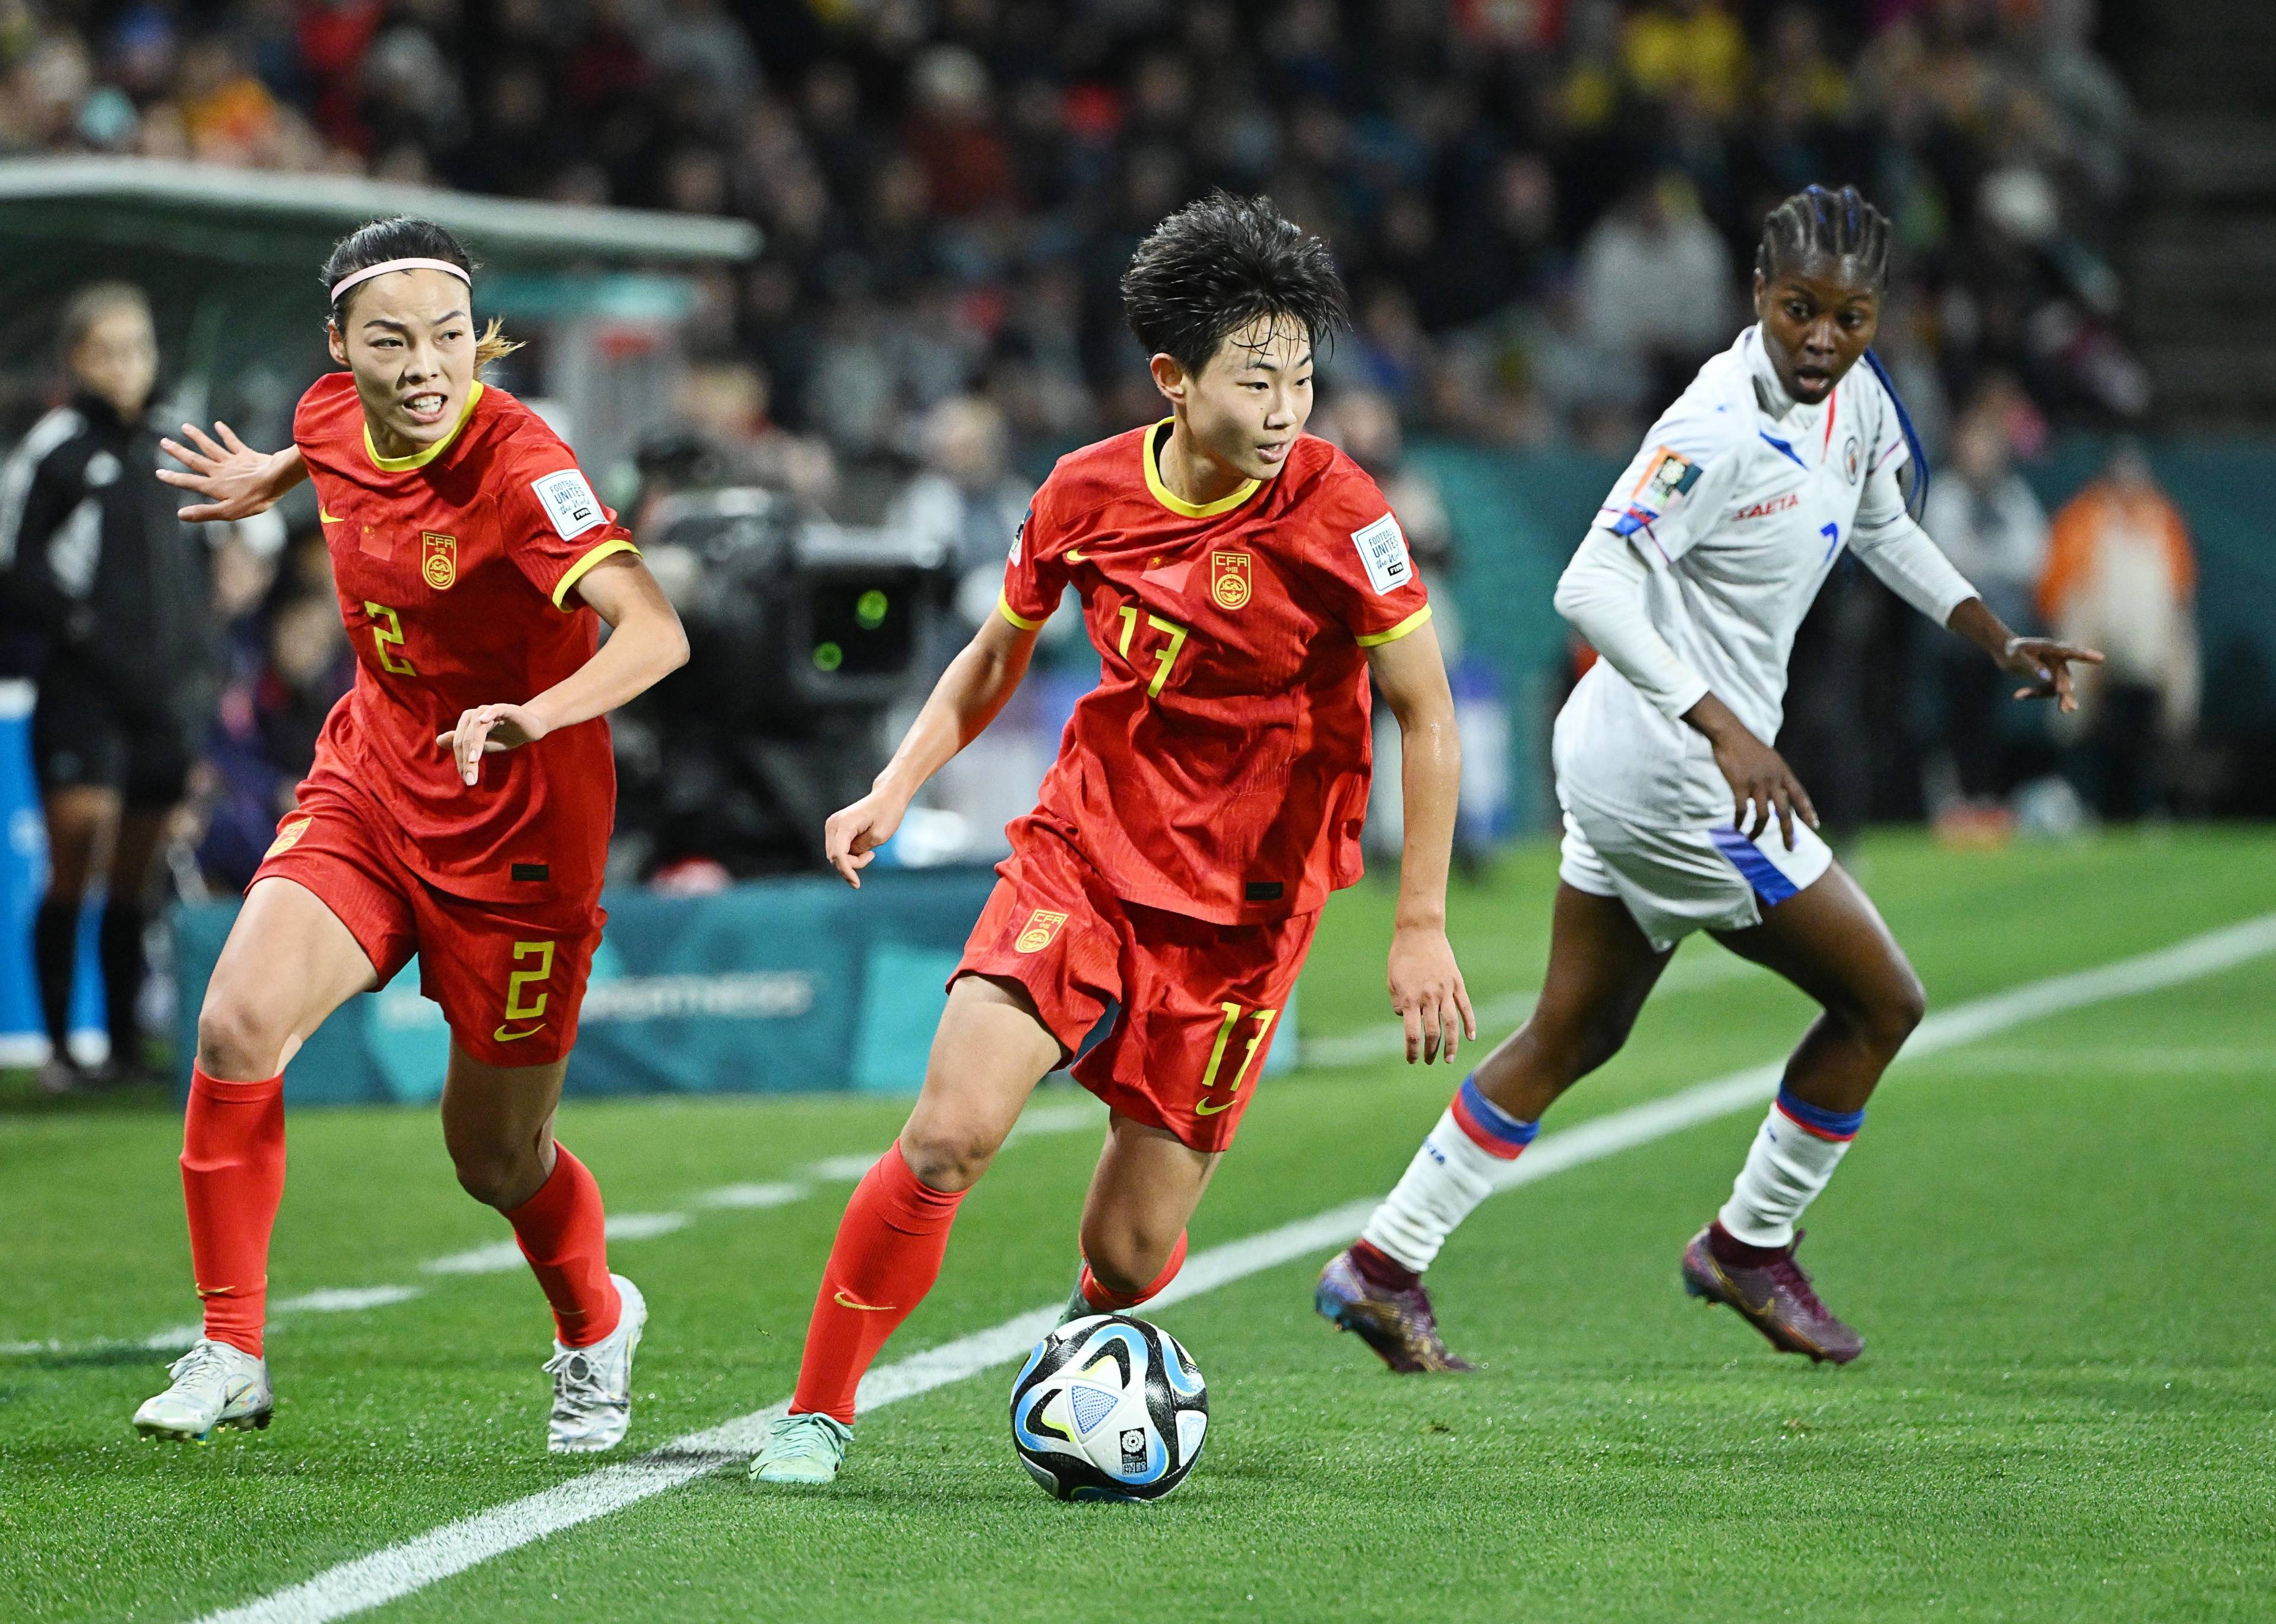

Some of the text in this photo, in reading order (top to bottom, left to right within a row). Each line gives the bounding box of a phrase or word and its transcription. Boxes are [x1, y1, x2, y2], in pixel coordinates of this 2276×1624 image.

[549, 479, 580, 494] FOOTBALL
[554, 486, 585, 504] UNITES
[560, 504, 572, 515] the
[426, 536, 454, 549] CFA
[1368, 527, 1394, 547] FOOTBALL
[1820, 522, 1838, 562] 7
[1372, 536, 1399, 558] UNITES
[1215, 555, 1248, 567] CFA
[1375, 558, 1388, 569] the
[1389, 564, 1403, 574] FIFA
[364, 600, 417, 677] 2
[1119, 606, 1188, 698] 17
[1033, 912, 1064, 925] CFA
[505, 941, 555, 1020] 2
[1201, 1002, 1277, 1091] 17
